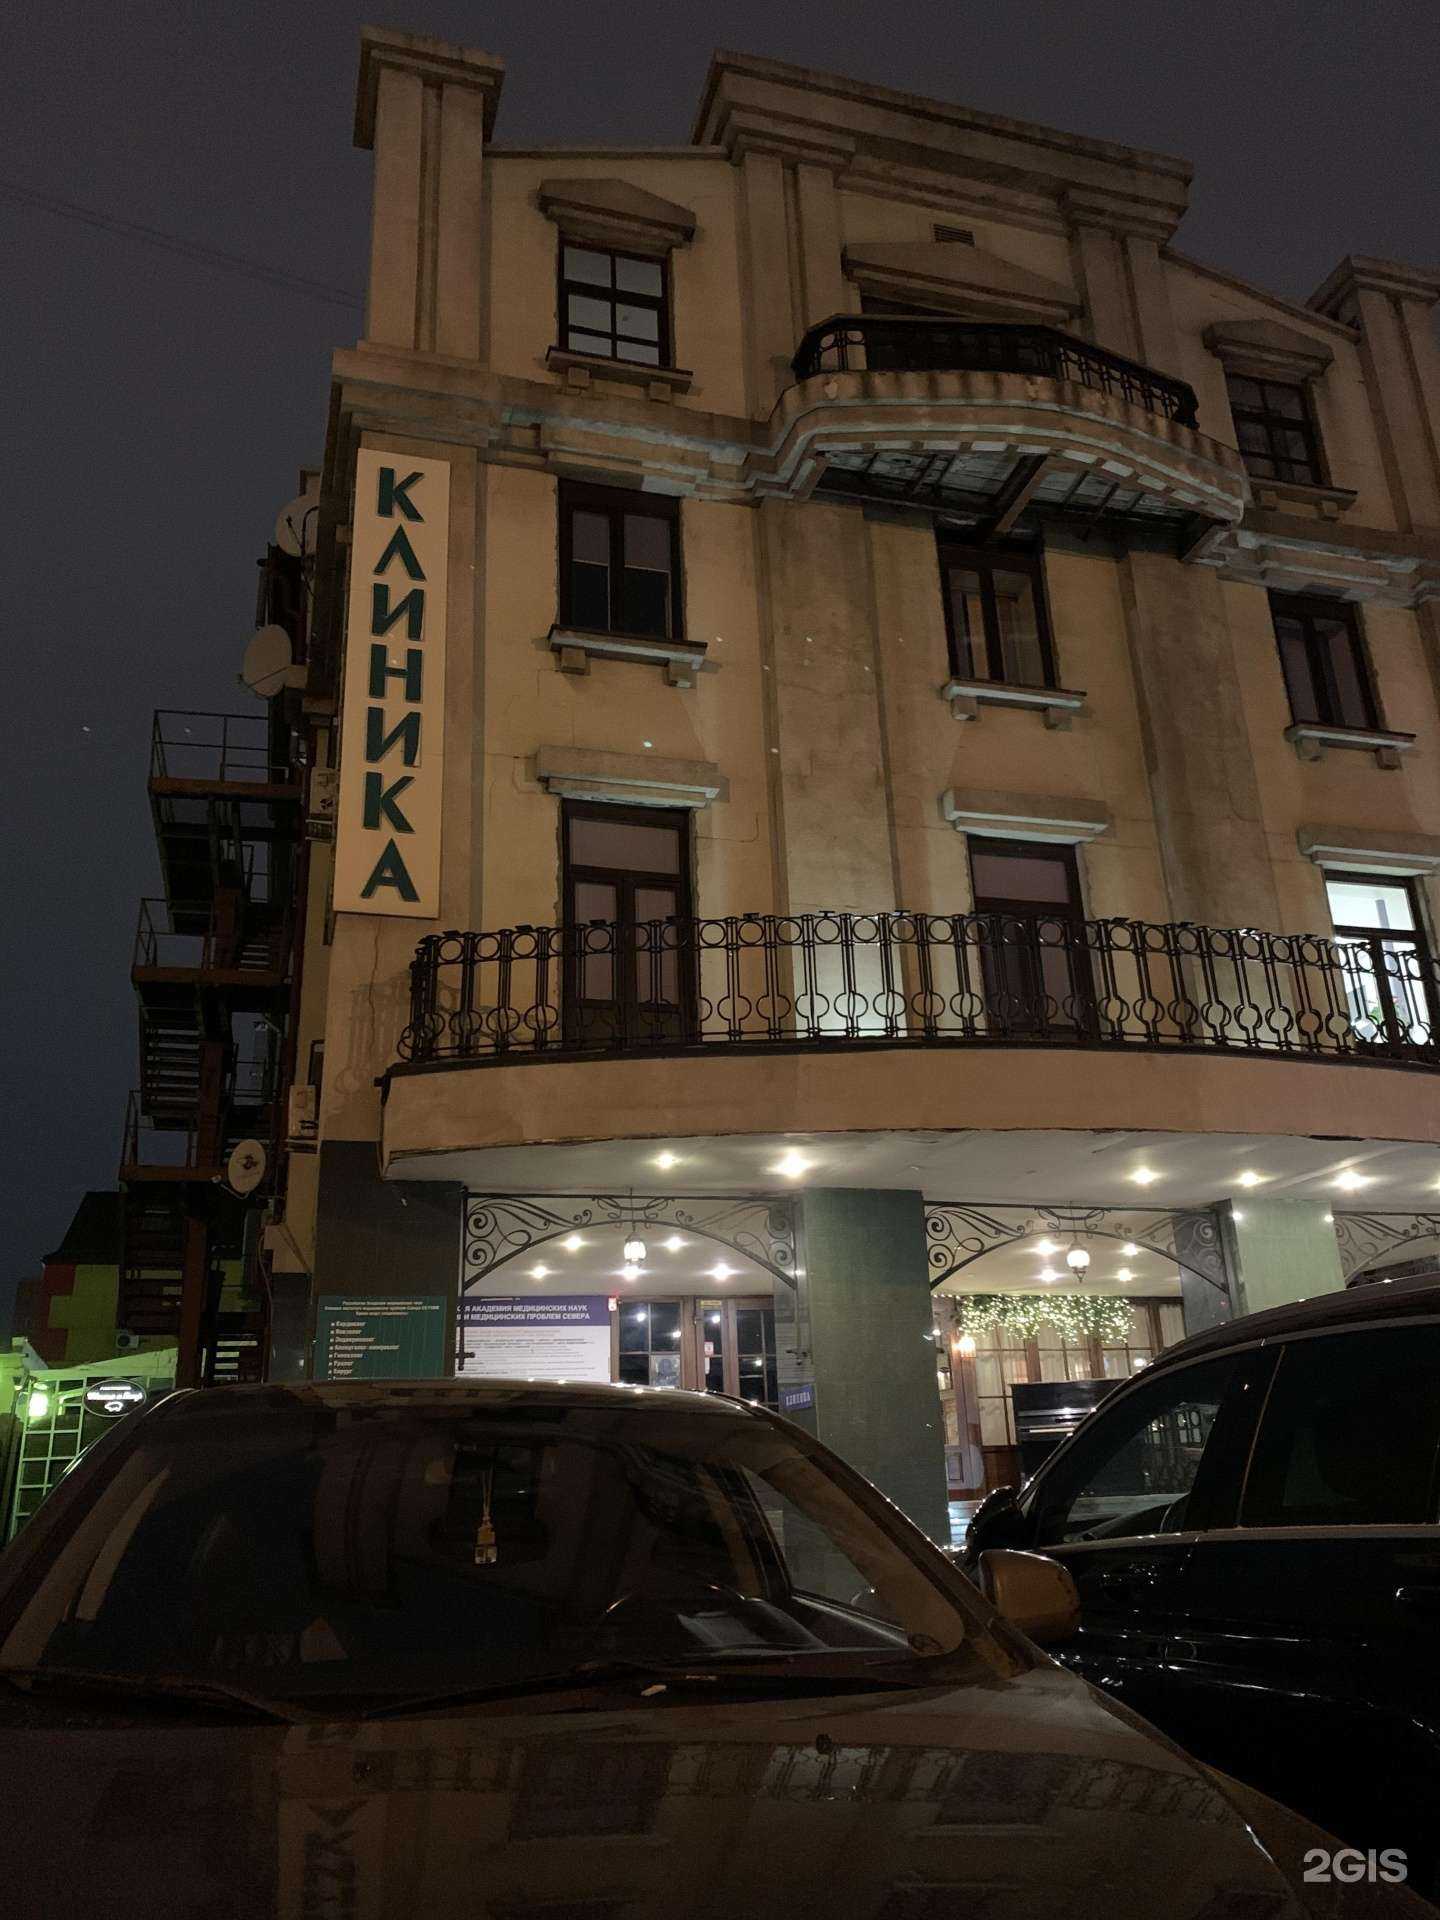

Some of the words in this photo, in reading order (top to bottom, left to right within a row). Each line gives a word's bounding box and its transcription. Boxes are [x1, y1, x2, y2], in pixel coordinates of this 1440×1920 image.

[360, 466, 427, 903] КЛИНИКА
[513, 1304, 567, 1312] МЕДИЦИНСКИХ
[568, 1304, 588, 1312] НАУК
[471, 1313, 526, 1321] МЕДИЦИНСКИХ
[562, 1312, 590, 1320] СЕВЕРА
